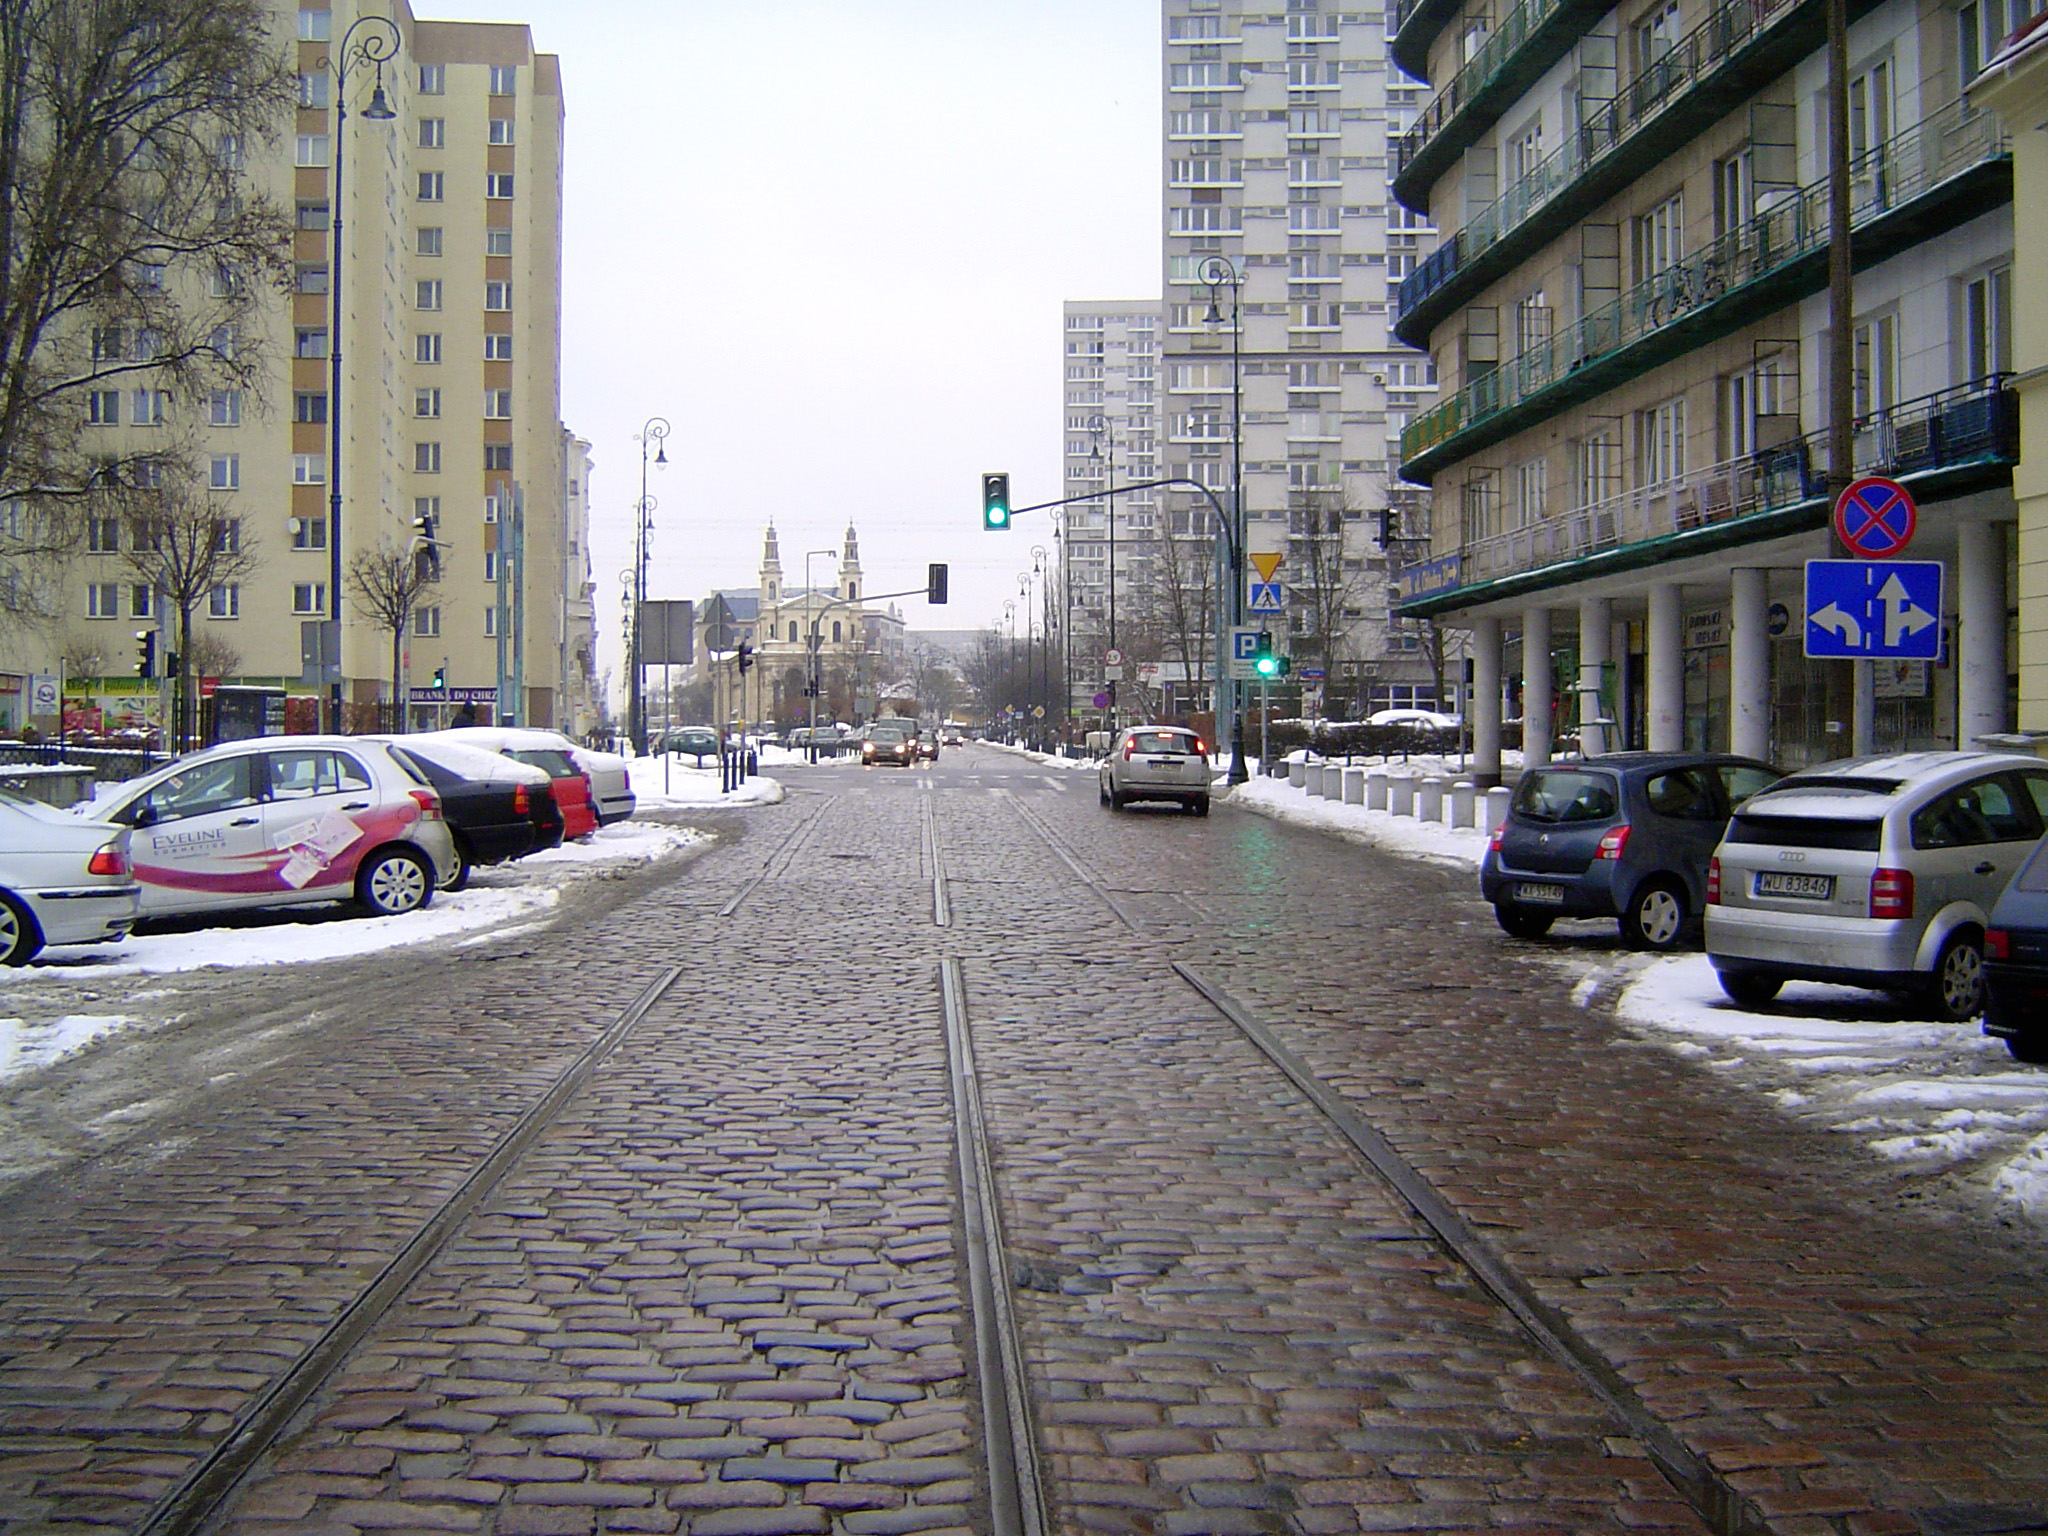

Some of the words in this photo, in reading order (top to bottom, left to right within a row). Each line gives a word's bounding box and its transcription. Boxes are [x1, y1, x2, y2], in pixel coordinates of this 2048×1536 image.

[1240, 635, 1257, 657] P
[454, 690, 469, 700] DO
[153, 828, 224, 850] EVELINE
[1784, 876, 1827, 894] 83846
